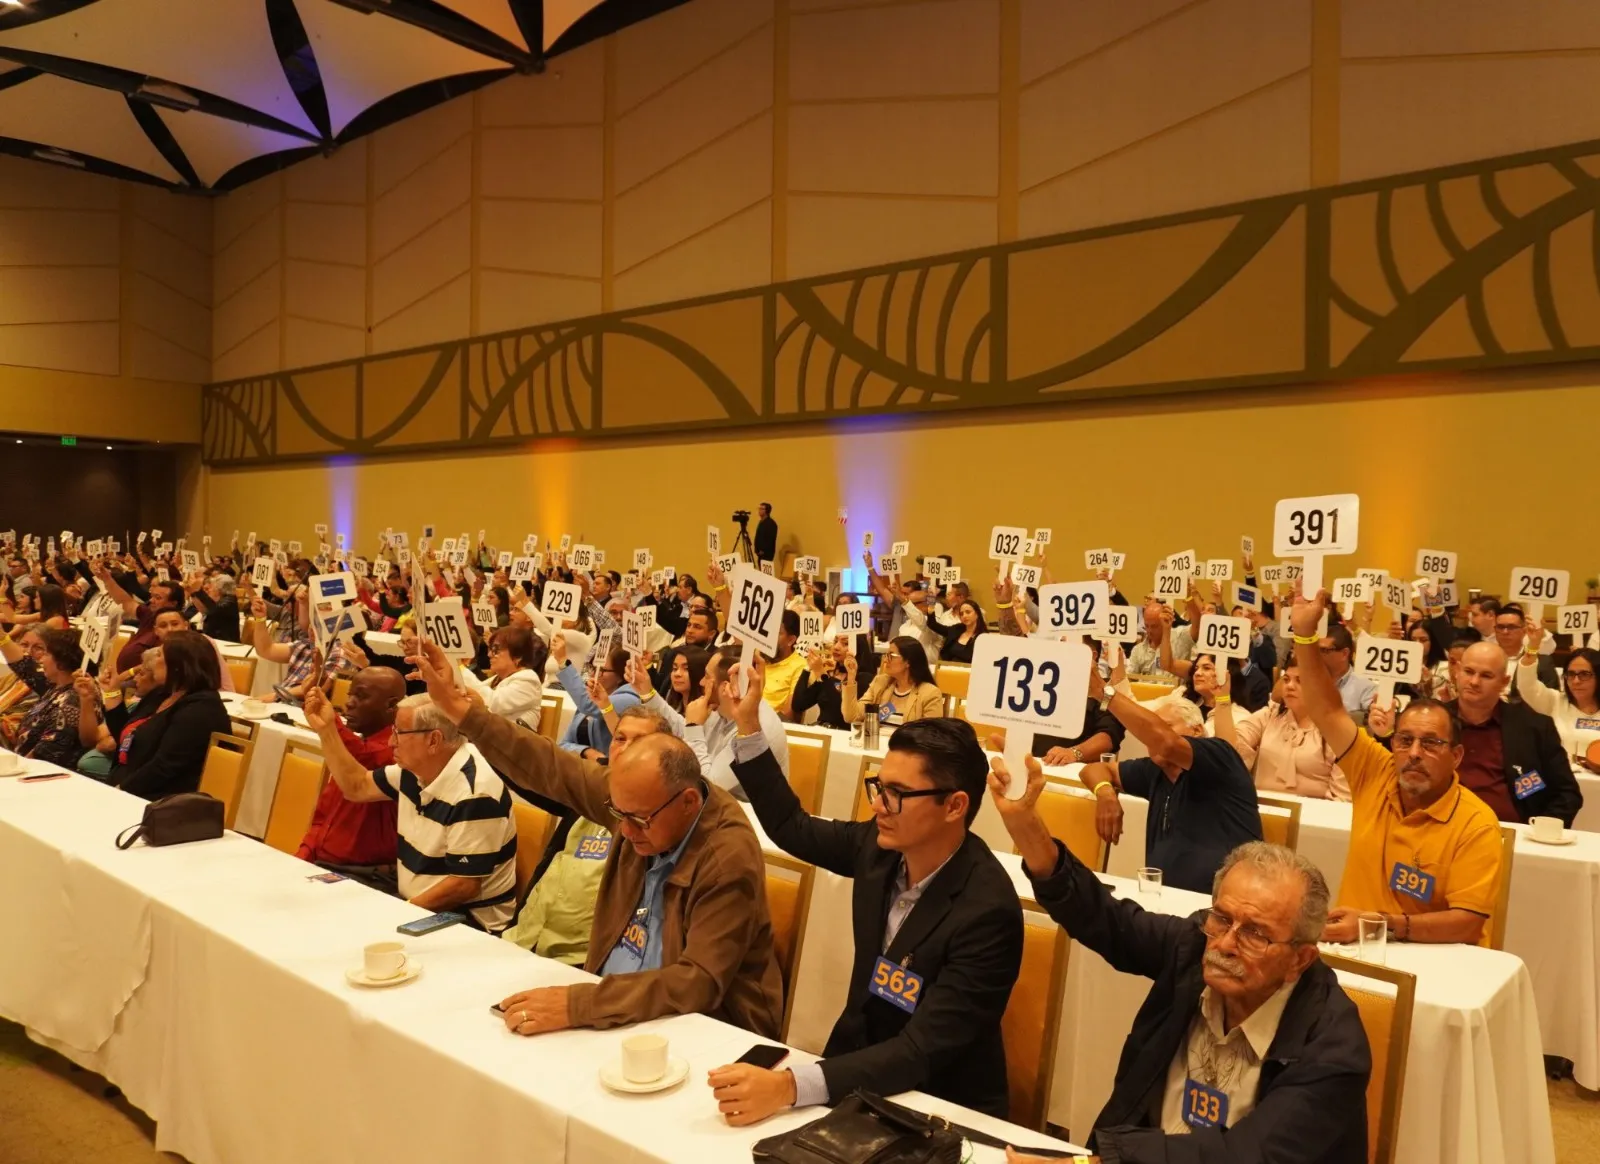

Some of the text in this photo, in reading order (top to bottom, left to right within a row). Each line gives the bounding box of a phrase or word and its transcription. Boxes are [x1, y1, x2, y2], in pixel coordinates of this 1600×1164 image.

[1036, 532, 1048, 541] 293
[1289, 508, 1339, 546] 391
[995, 533, 1020, 556] 032
[574, 550, 591, 566] 066
[806, 559, 817, 571] 574
[882, 558, 898, 571] 695
[1089, 553, 1108, 566] 264
[1422, 555, 1449, 574] 689
[255, 563, 270, 580] 081
[514, 561, 530, 576] 194
[927, 562, 941, 574] 189
[943, 570, 957, 581] 395
[1015, 568, 1036, 583] 578
[1210, 564, 1228, 576] 373
[1159, 576, 1182, 594] 220
[1340, 583, 1362, 598] 196
[1519, 575, 1558, 599] 290
[547, 589, 573, 614] 229
[1387, 584, 1405, 607] 351
[476, 608, 493, 623] 200
[738, 580, 774, 638] 562
[1050, 593, 1096, 627] 392
[803, 617, 820, 635] 094
[842, 609, 862, 629] 019
[1564, 611, 1589, 629] 287
[85, 625, 100, 653] 103
[425, 615, 462, 649] 505
[626, 619, 639, 647] 615
[1206, 623, 1240, 650] 035
[1365, 646, 1409, 675] 295
[993, 656, 1060, 717] 133
[1515, 772, 1542, 794] 295
[580, 839, 609, 854] 505
[1396, 865, 1429, 894] 391
[873, 961, 921, 1003] 562
[1190, 1088, 1220, 1122] 133
